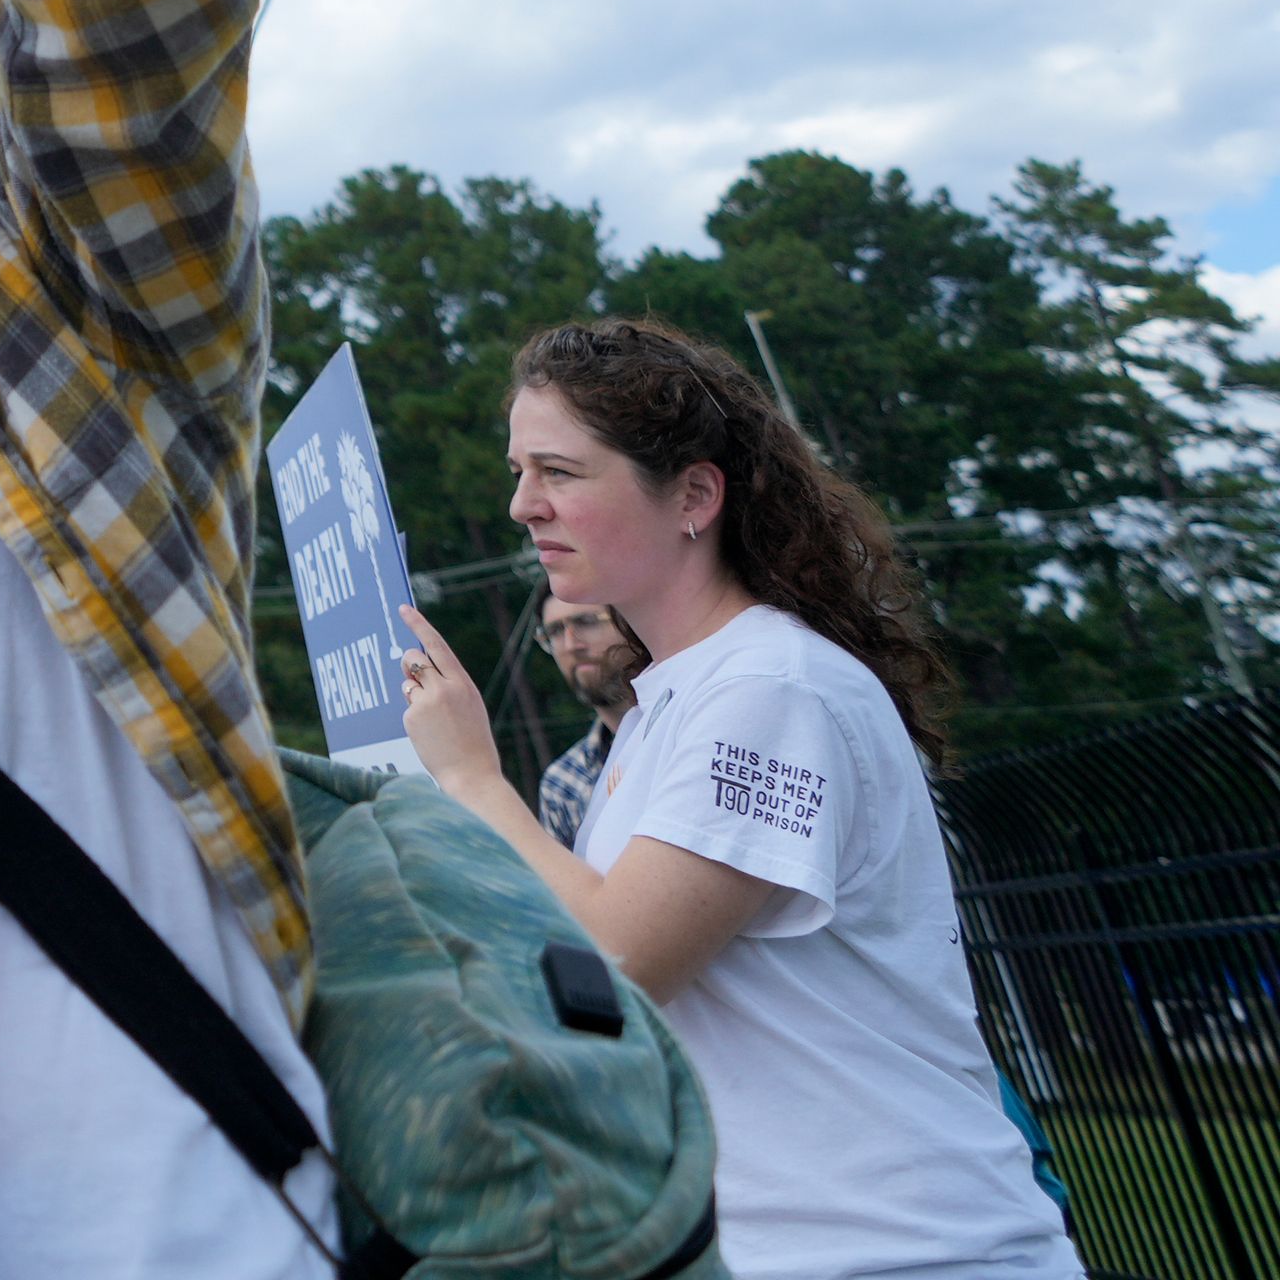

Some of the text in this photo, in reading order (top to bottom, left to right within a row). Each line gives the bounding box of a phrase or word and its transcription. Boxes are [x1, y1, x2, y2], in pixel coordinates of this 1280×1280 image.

[277, 432, 331, 525] END THE
[294, 521, 356, 621] DEATH
[316, 633, 390, 721] PENALTY
[711, 758, 823, 808] KEEPS MEN
[714, 741, 827, 790] THIS SHIRT
[710, 775, 751, 815] T90
[756, 791, 819, 821] OUT OF
[753, 808, 812, 838] PRISON
